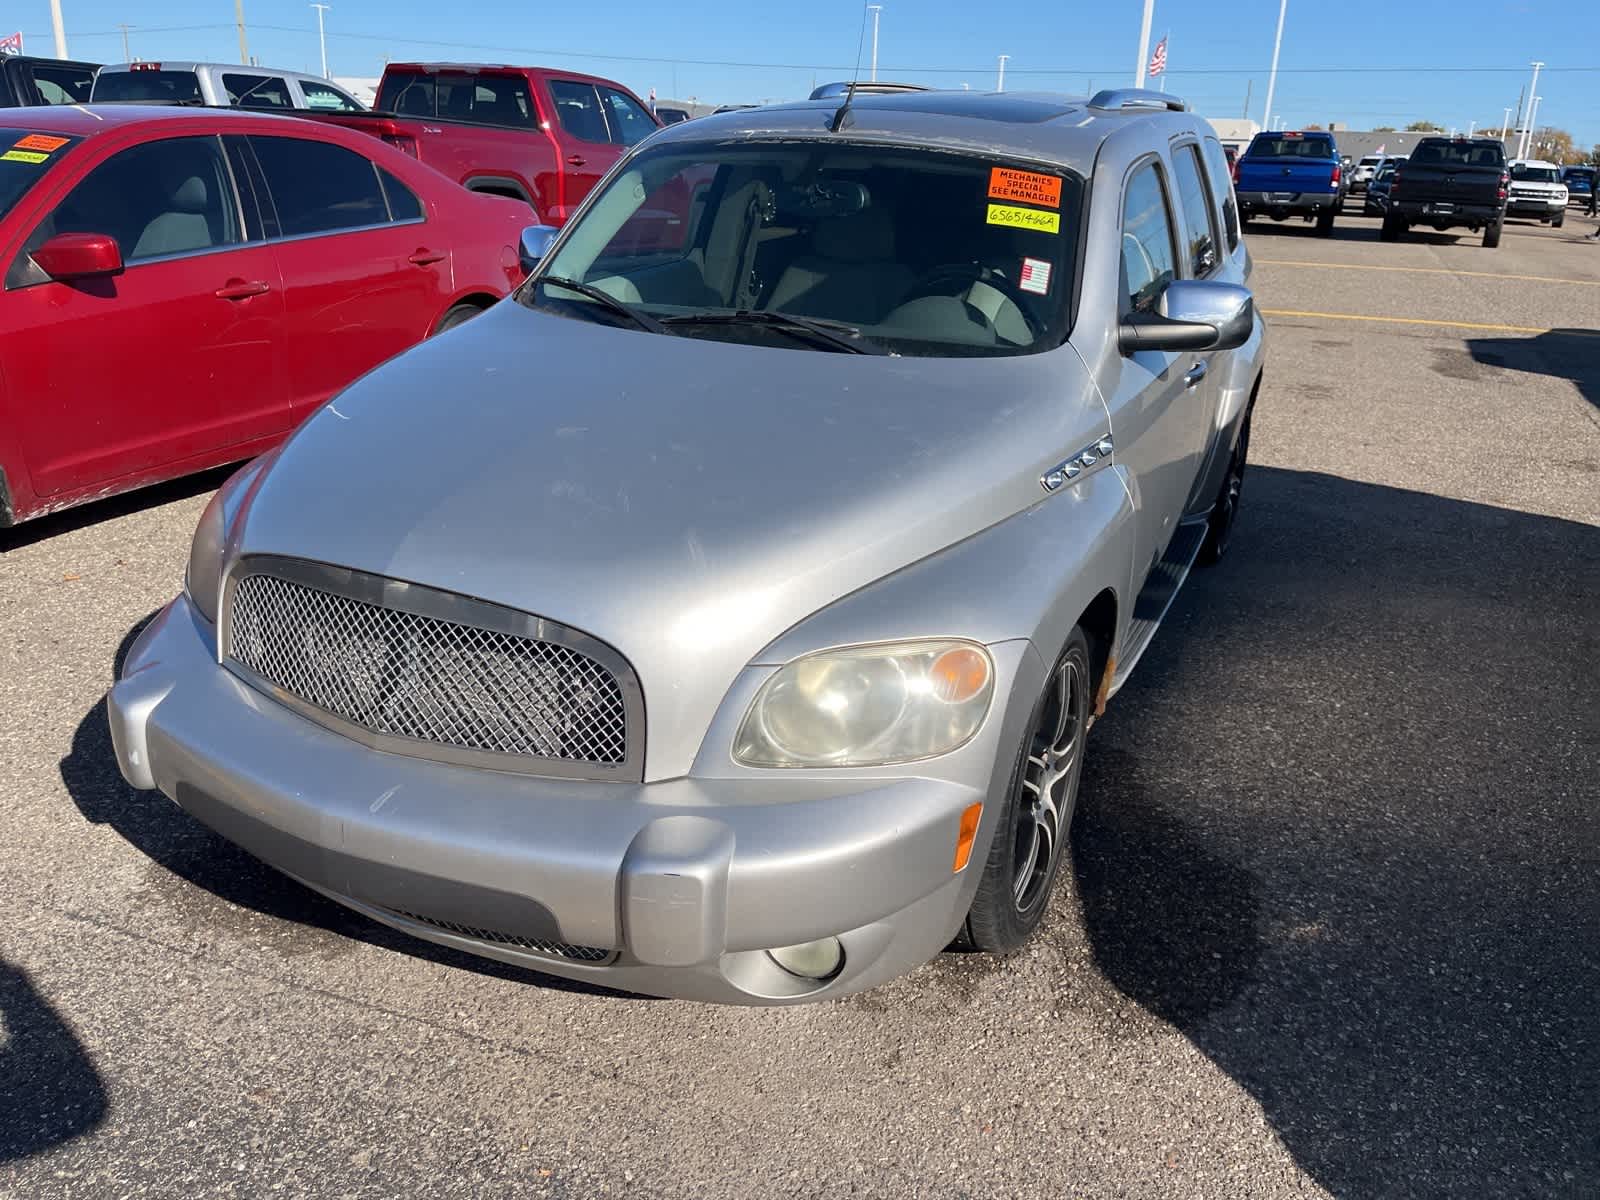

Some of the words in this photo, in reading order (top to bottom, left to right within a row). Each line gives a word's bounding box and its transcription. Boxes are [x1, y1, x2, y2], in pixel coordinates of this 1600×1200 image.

[1000, 171, 1052, 186] MECHANICS
[1007, 180, 1044, 192] SPECIAL
[992, 187, 1009, 195] SEE
[1011, 189, 1056, 203] MANAGER
